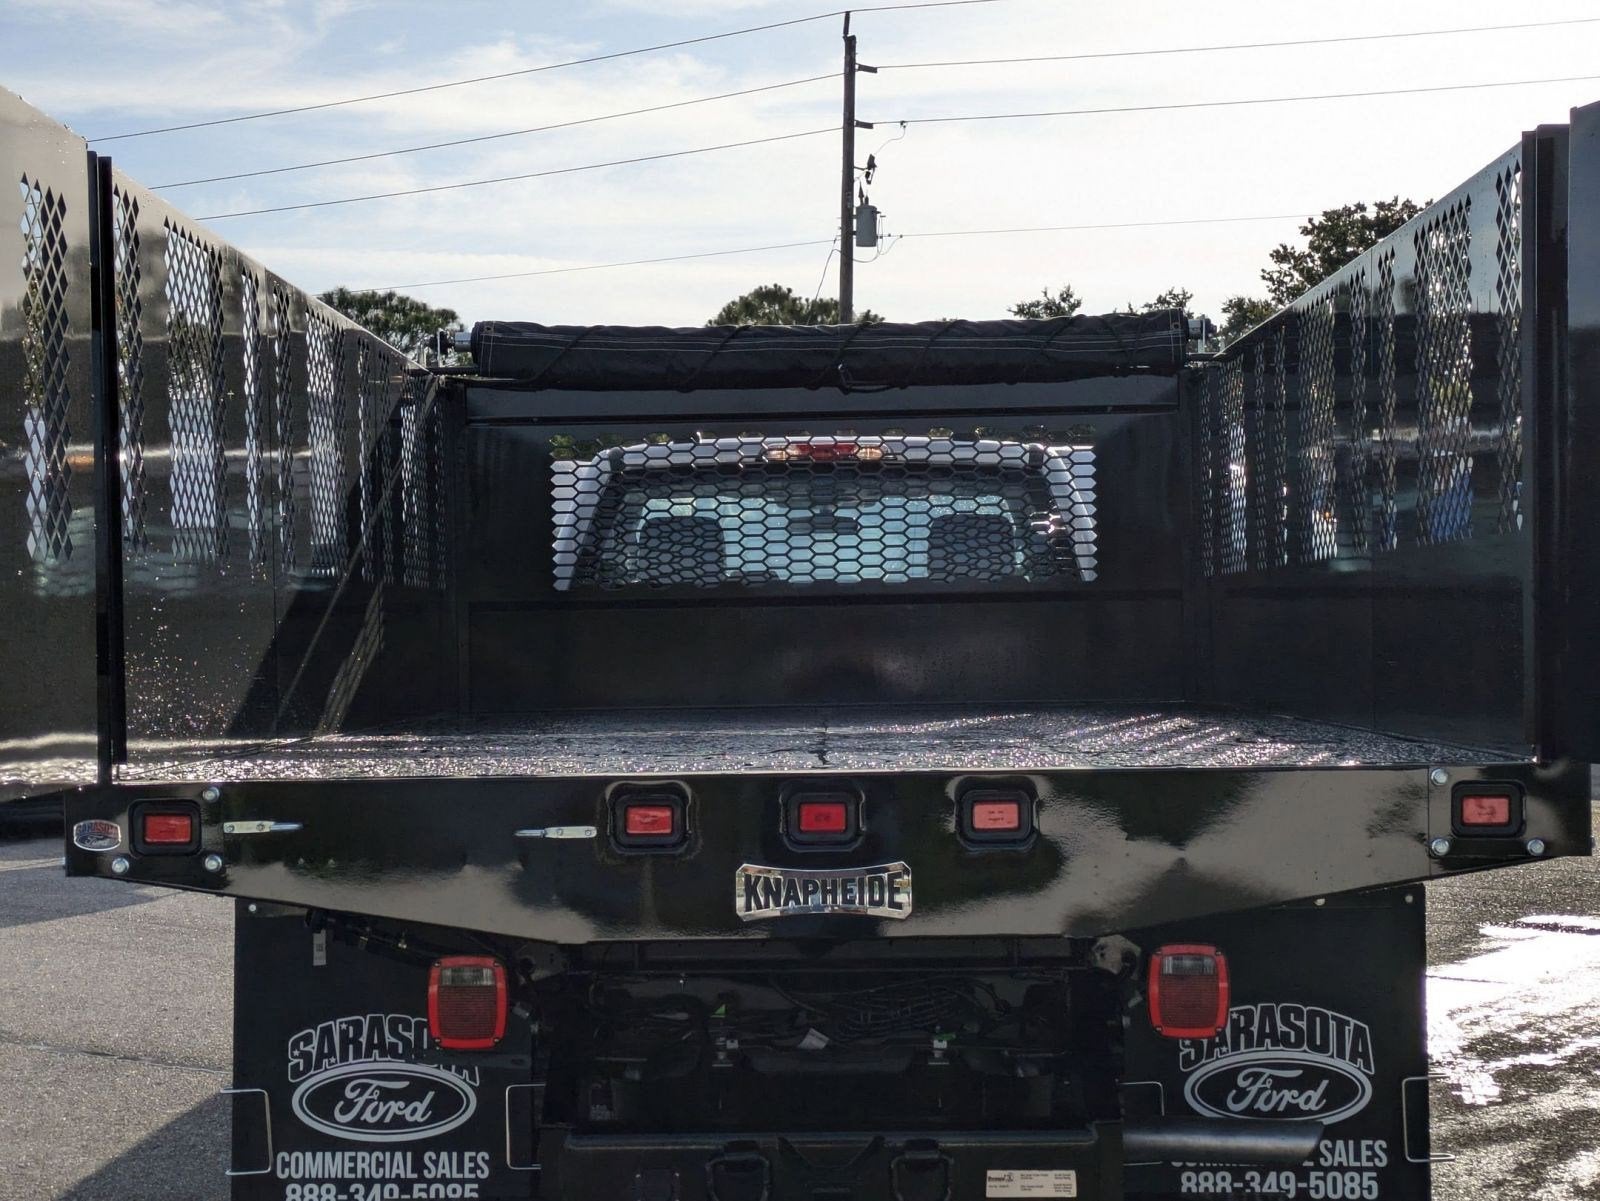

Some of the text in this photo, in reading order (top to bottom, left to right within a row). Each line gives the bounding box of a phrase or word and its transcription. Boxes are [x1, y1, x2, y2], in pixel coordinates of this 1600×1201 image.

[743, 870, 904, 913] KNAPHEIDE
[333, 1078, 435, 1124] Ford
[1226, 1067, 1330, 1113] Ford
[276, 1151, 490, 1179] COMMERCIAL SALES
[1319, 1139, 1388, 1168] SALES
[1180, 1171, 1379, 1200] 888-349-5085
